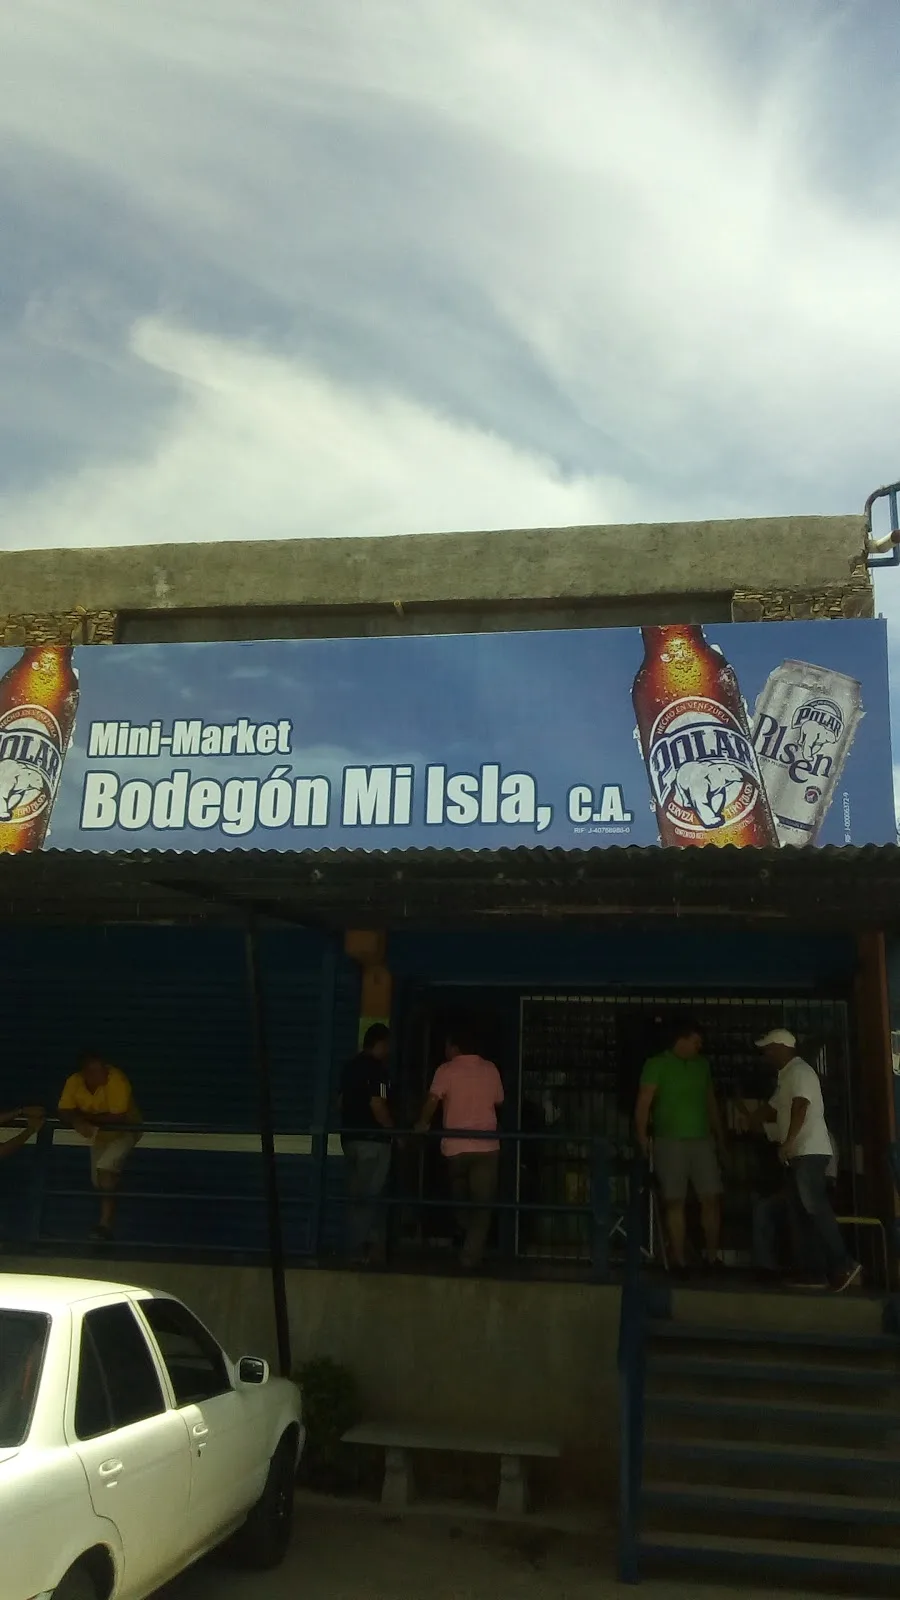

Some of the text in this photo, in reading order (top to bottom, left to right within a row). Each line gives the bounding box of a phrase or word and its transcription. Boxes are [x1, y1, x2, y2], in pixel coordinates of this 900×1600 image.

[88, 718, 292, 757] Mini-Market
[656, 701, 730, 735] HECHO EN VENEZUELA
[793, 706, 843, 739] POLAR
[0, 732, 60, 781] OLAR
[652, 730, 752, 792] POLAR
[751, 713, 833, 784] Pilsen
[80, 763, 632, 836] Bodegón Mi Isla, C.A.
[668, 802, 695, 823] CERVEZA
